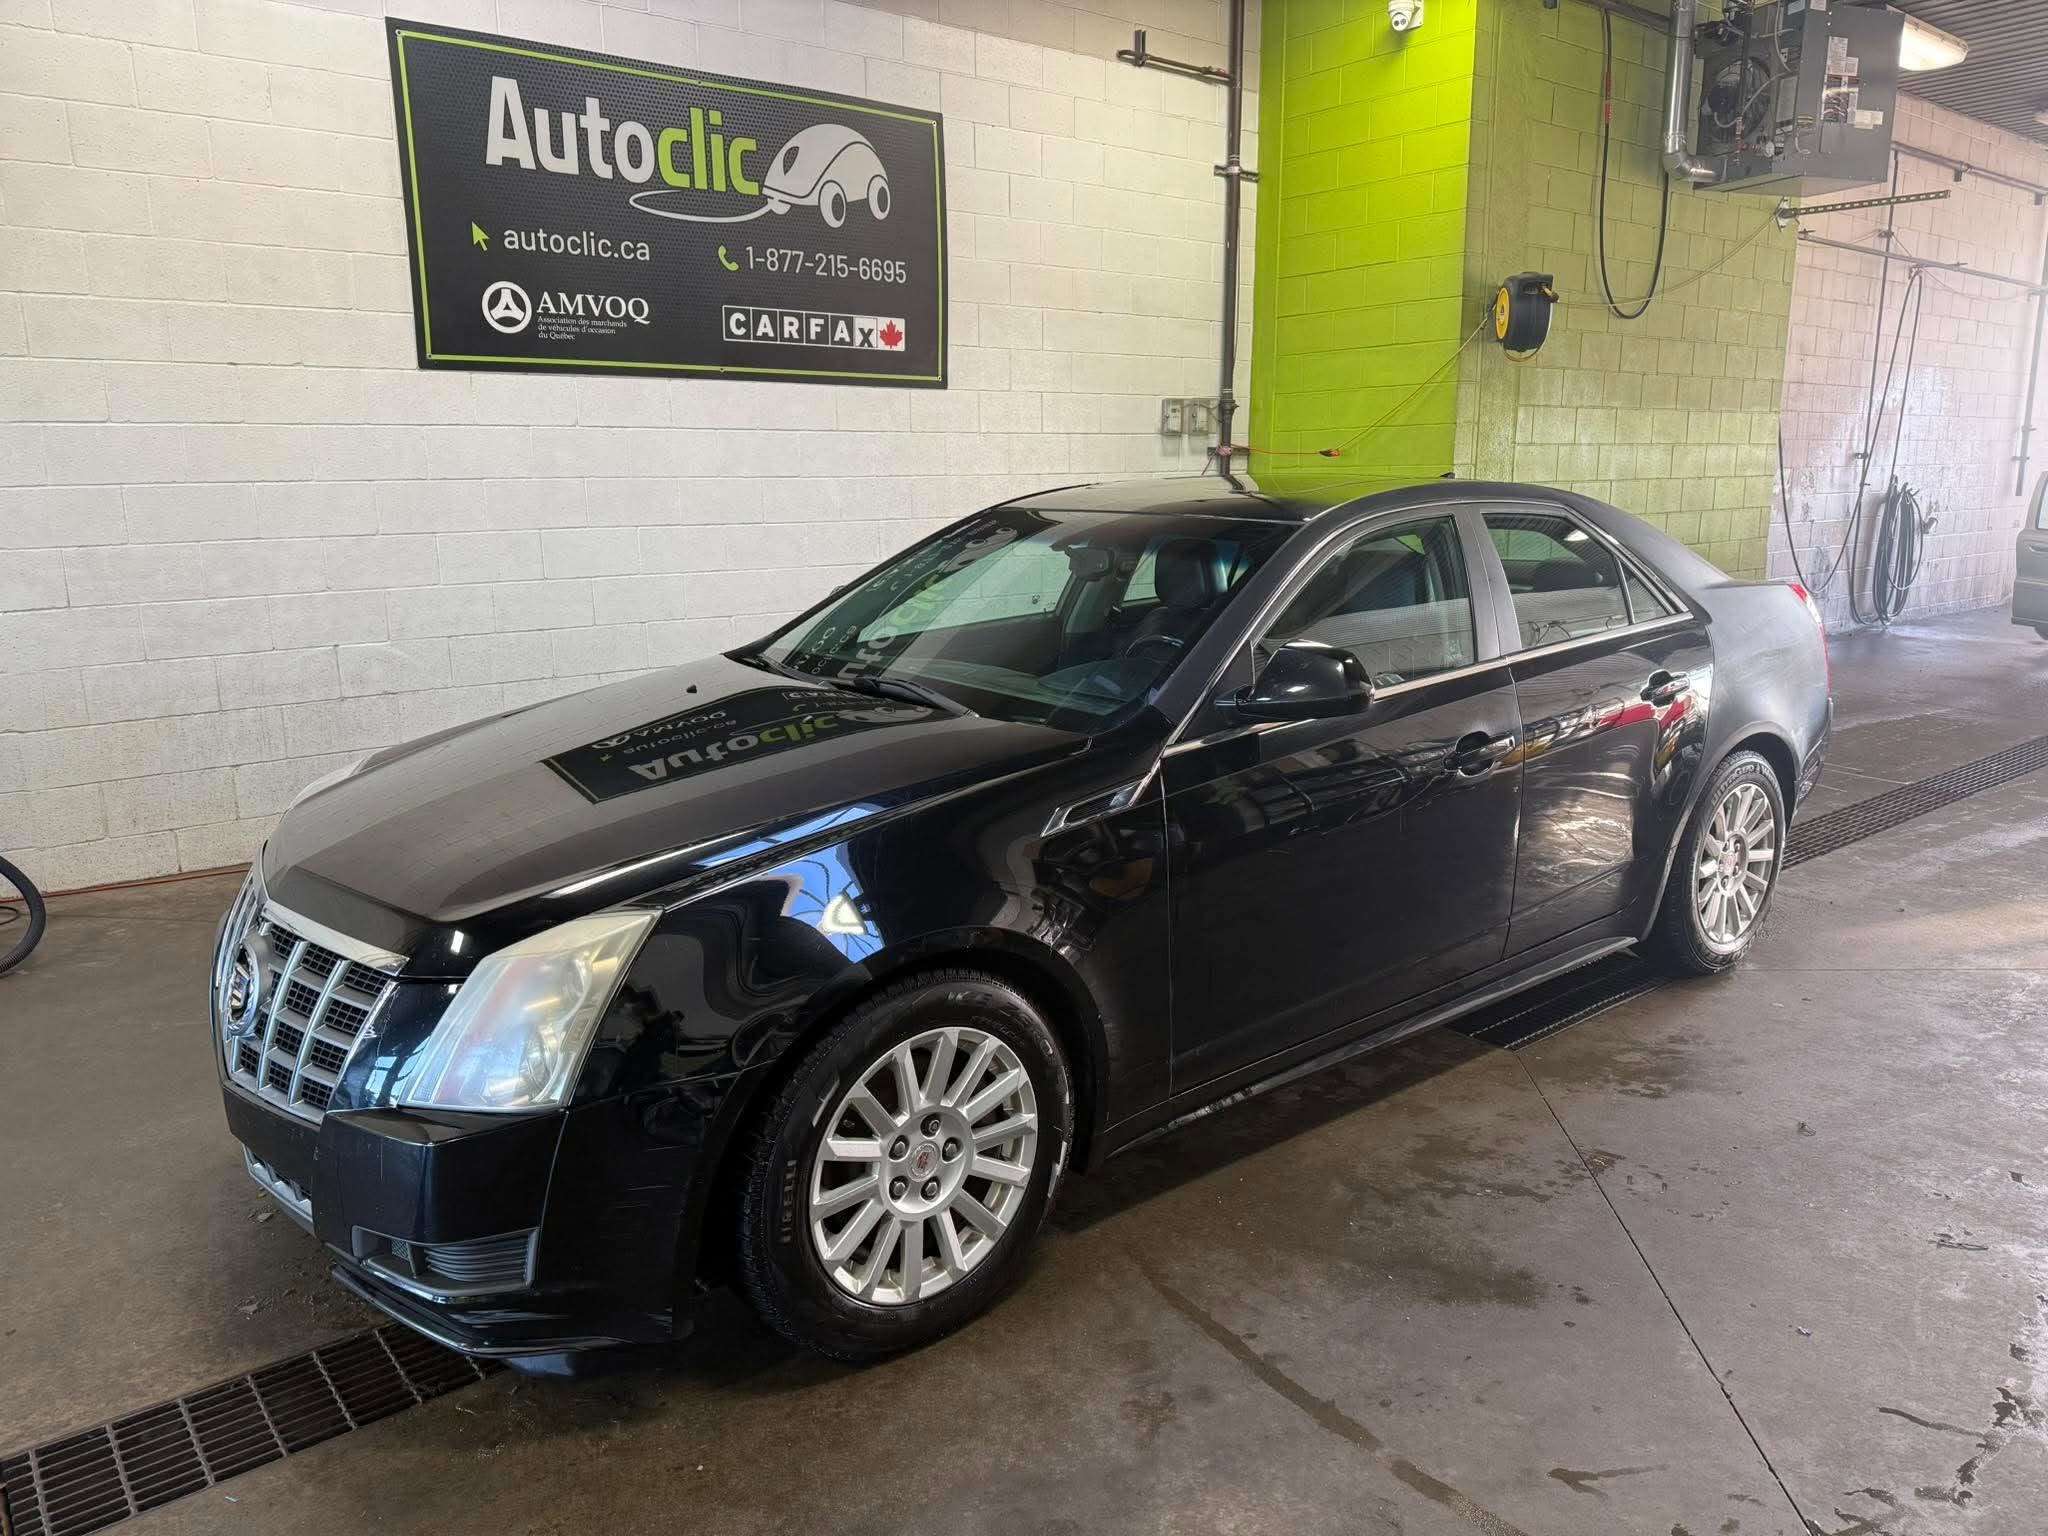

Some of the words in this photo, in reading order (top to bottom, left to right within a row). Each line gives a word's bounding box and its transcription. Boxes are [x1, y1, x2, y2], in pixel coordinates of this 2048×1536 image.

[485, 75, 760, 196] Autoclic
[503, 228, 651, 261] autoclic.ca
[745, 246, 907, 284] 1-877-215-6695
[536, 291, 650, 325] AMVOQ
[537, 315, 577, 325] Association
[578, 317, 590, 325] des
[591, 319, 628, 328] marchands
[537, 323, 547, 331] de
[538, 331, 548, 339] du
[728, 312, 874, 348] CARFAX
